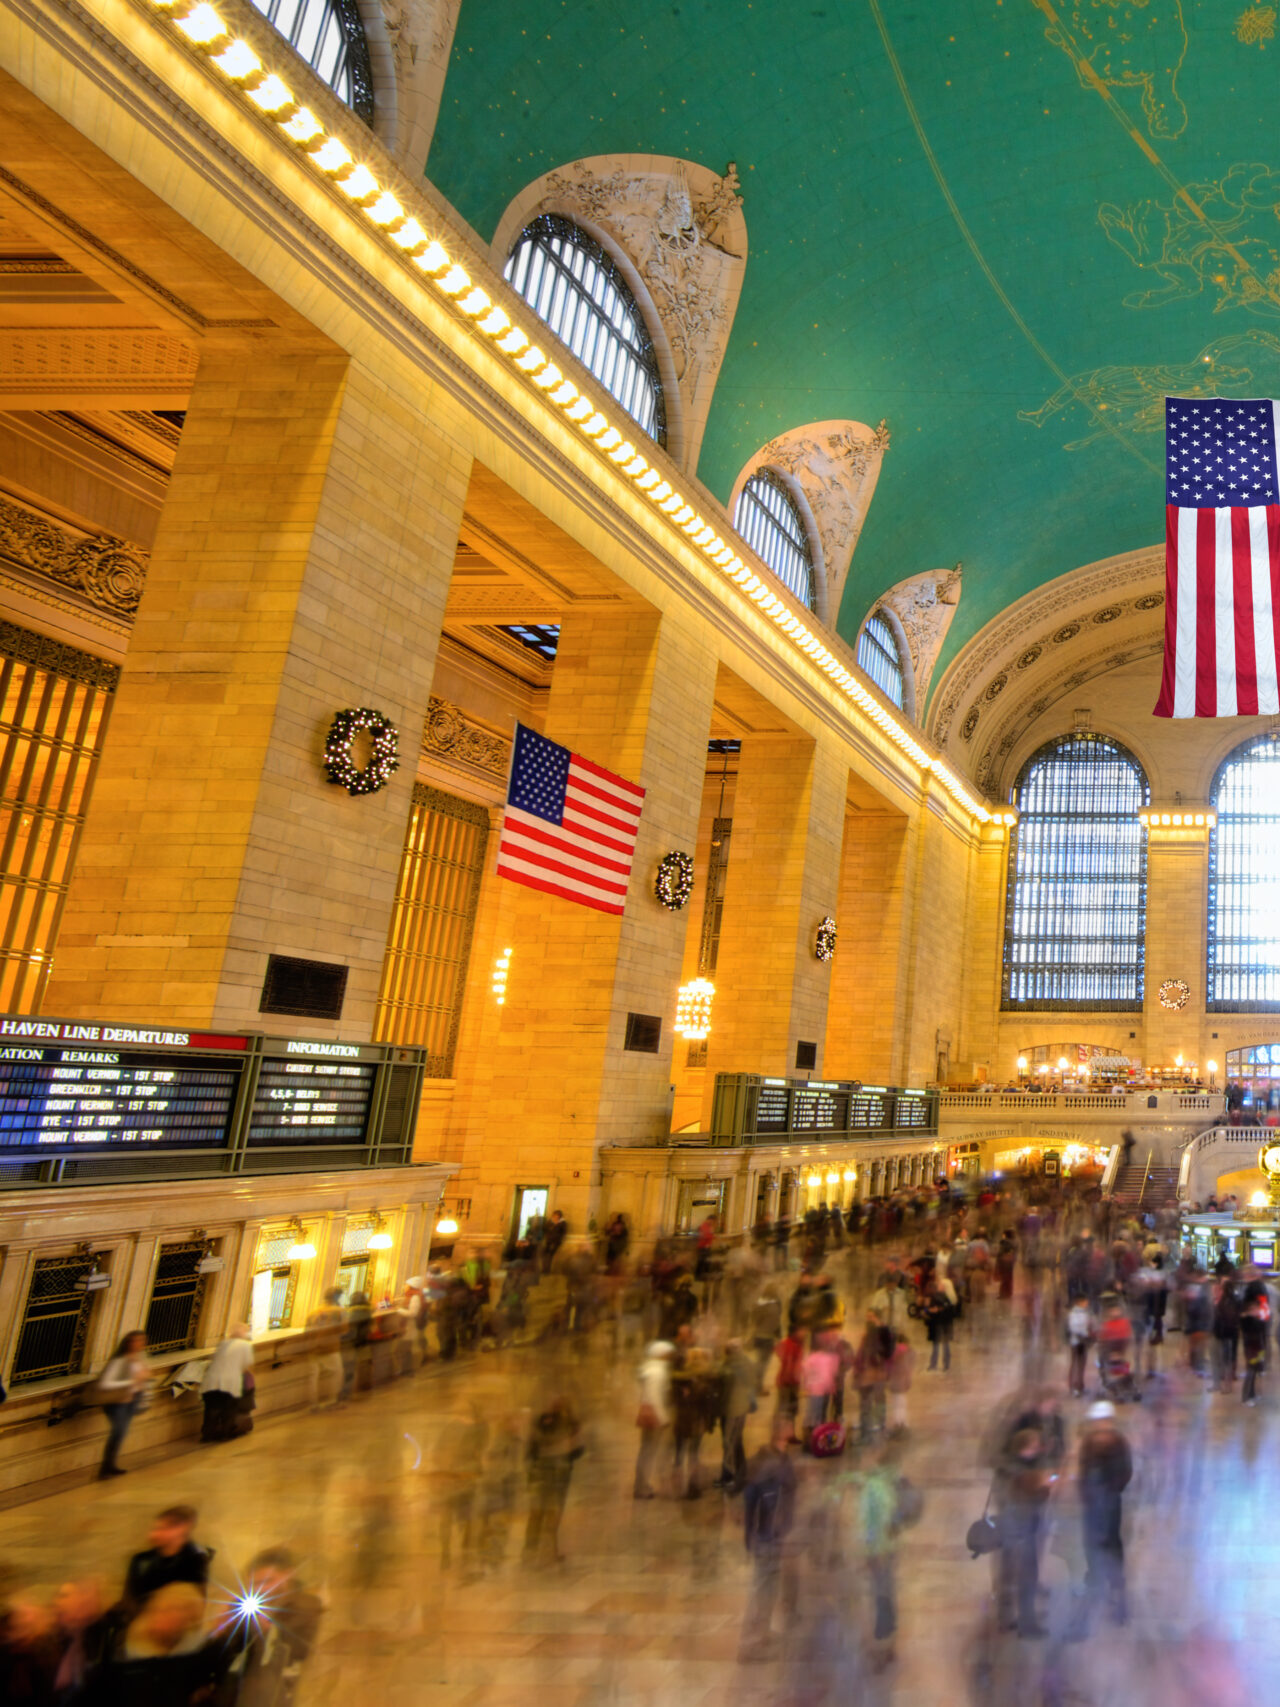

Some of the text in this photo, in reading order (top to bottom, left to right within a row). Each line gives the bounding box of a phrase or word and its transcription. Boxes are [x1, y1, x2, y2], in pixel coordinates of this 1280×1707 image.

[0, 1020, 190, 1046] HAVEN LINE DEPARTURES
[0, 1048, 44, 1060] ATION
[286, 1041, 360, 1057] INFORMATION
[60, 1051, 120, 1063] REMARKS
[52, 1068, 83, 1079] MOUNT
[86, 1069, 121, 1080] VERNON
[134, 1071, 151, 1081] 1ST
[152, 1071, 175, 1081] STOP
[49, 1084, 102, 1095] GREENWICH
[116, 1085, 133, 1095] 1ST
[134, 1086, 158, 1096] STOP
[45, 1100, 77, 1111] MOUNT
[79, 1100, 114, 1111] VERNON
[128, 1101, 145, 1111] 1ST
[147, 1101, 169, 1111] STOP
[312, 1102, 338, 1112] SERVICE
[42, 1115, 62, 1126] RYE
[78, 1115, 96, 1126] 1ST
[97, 1115, 122, 1126] STOP
[310, 1115, 337, 1125] SERVICE
[39, 1131, 70, 1143] MOUNT
[72, 1131, 108, 1142] VERNON
[122, 1130, 139, 1141] 1ST
[140, 1130, 163, 1140] STOP
